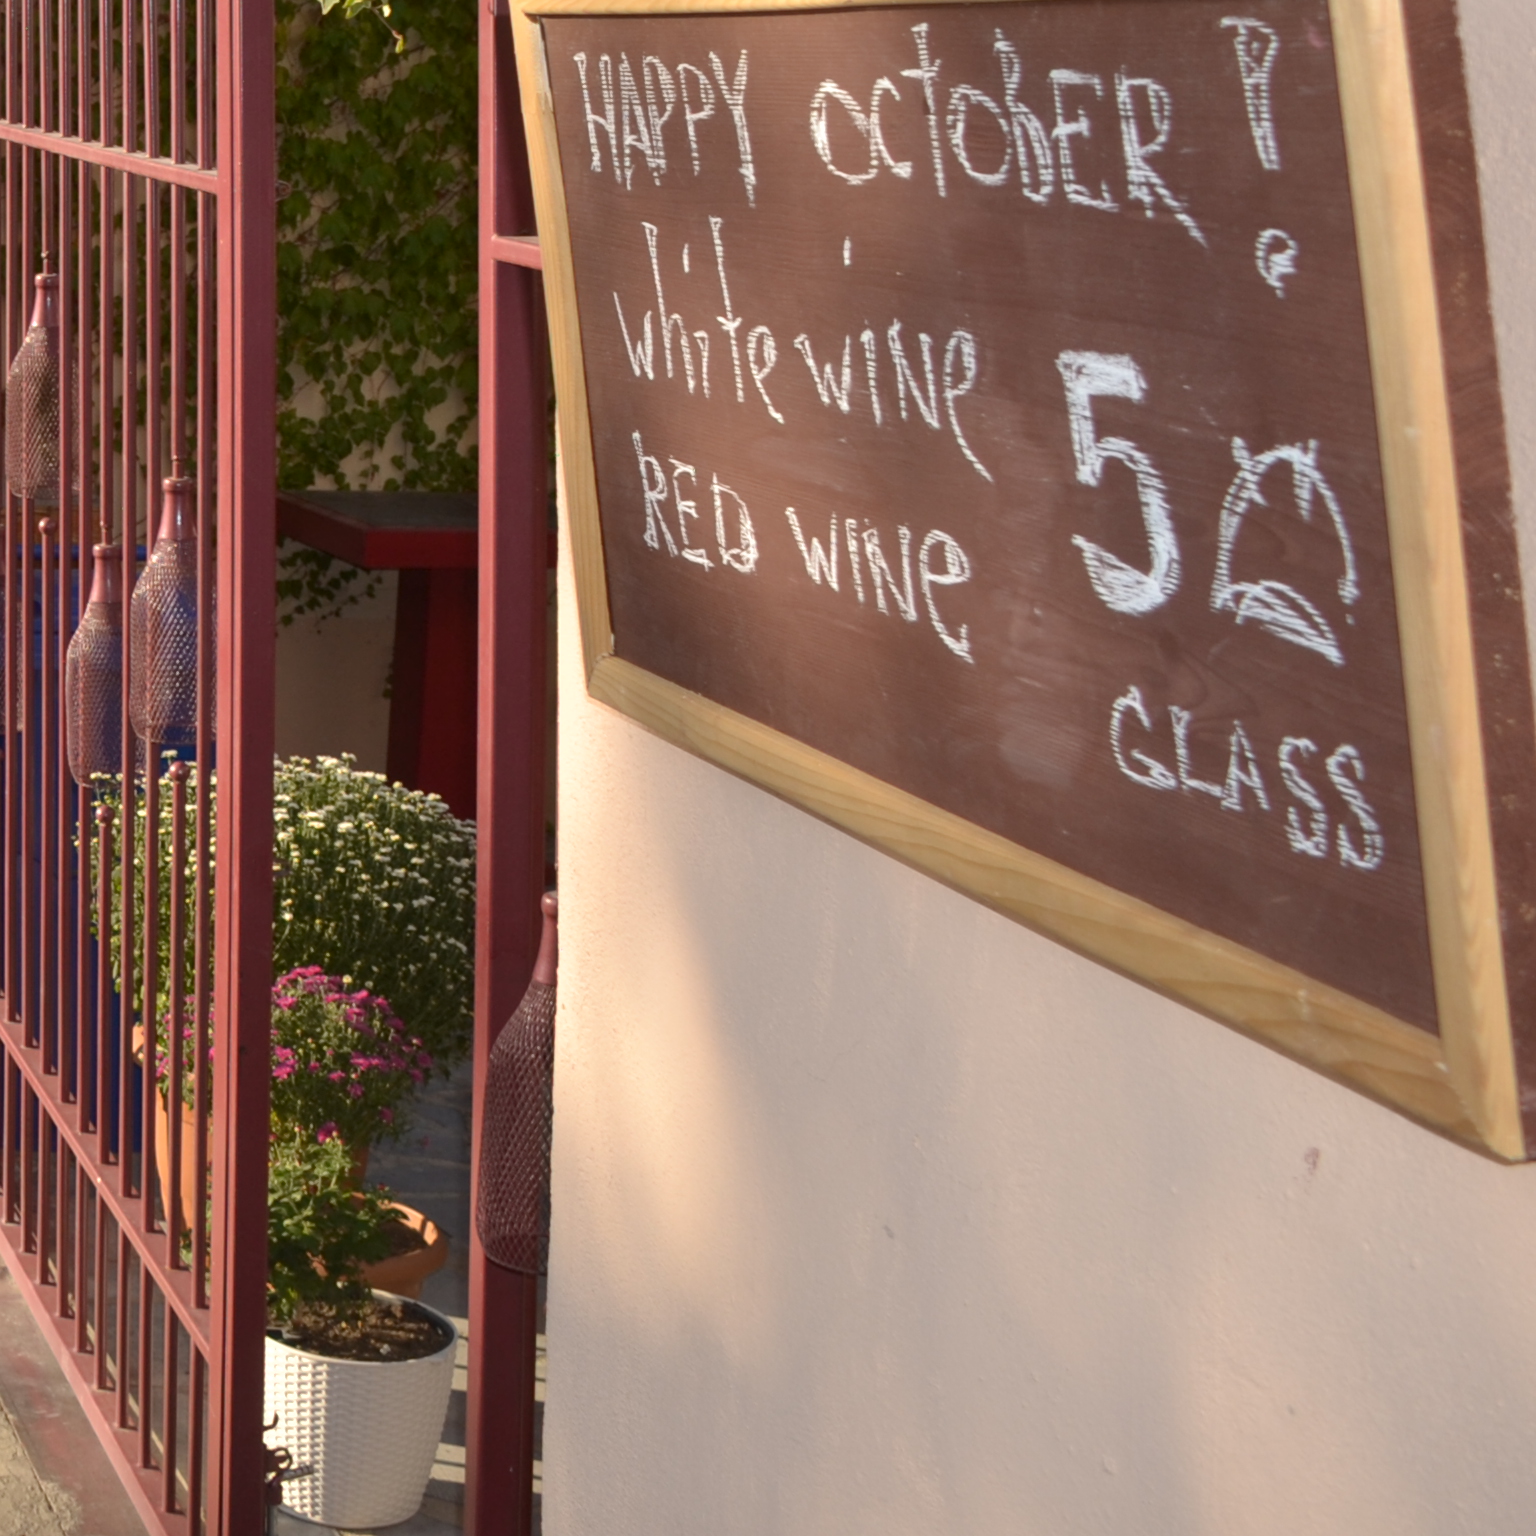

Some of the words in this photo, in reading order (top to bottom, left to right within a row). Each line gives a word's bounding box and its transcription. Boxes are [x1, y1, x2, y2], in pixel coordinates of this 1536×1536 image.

[573, 48, 756, 208] HAPPY
[631, 430, 759, 577] RED
[1109, 685, 1384, 871] GLASS
